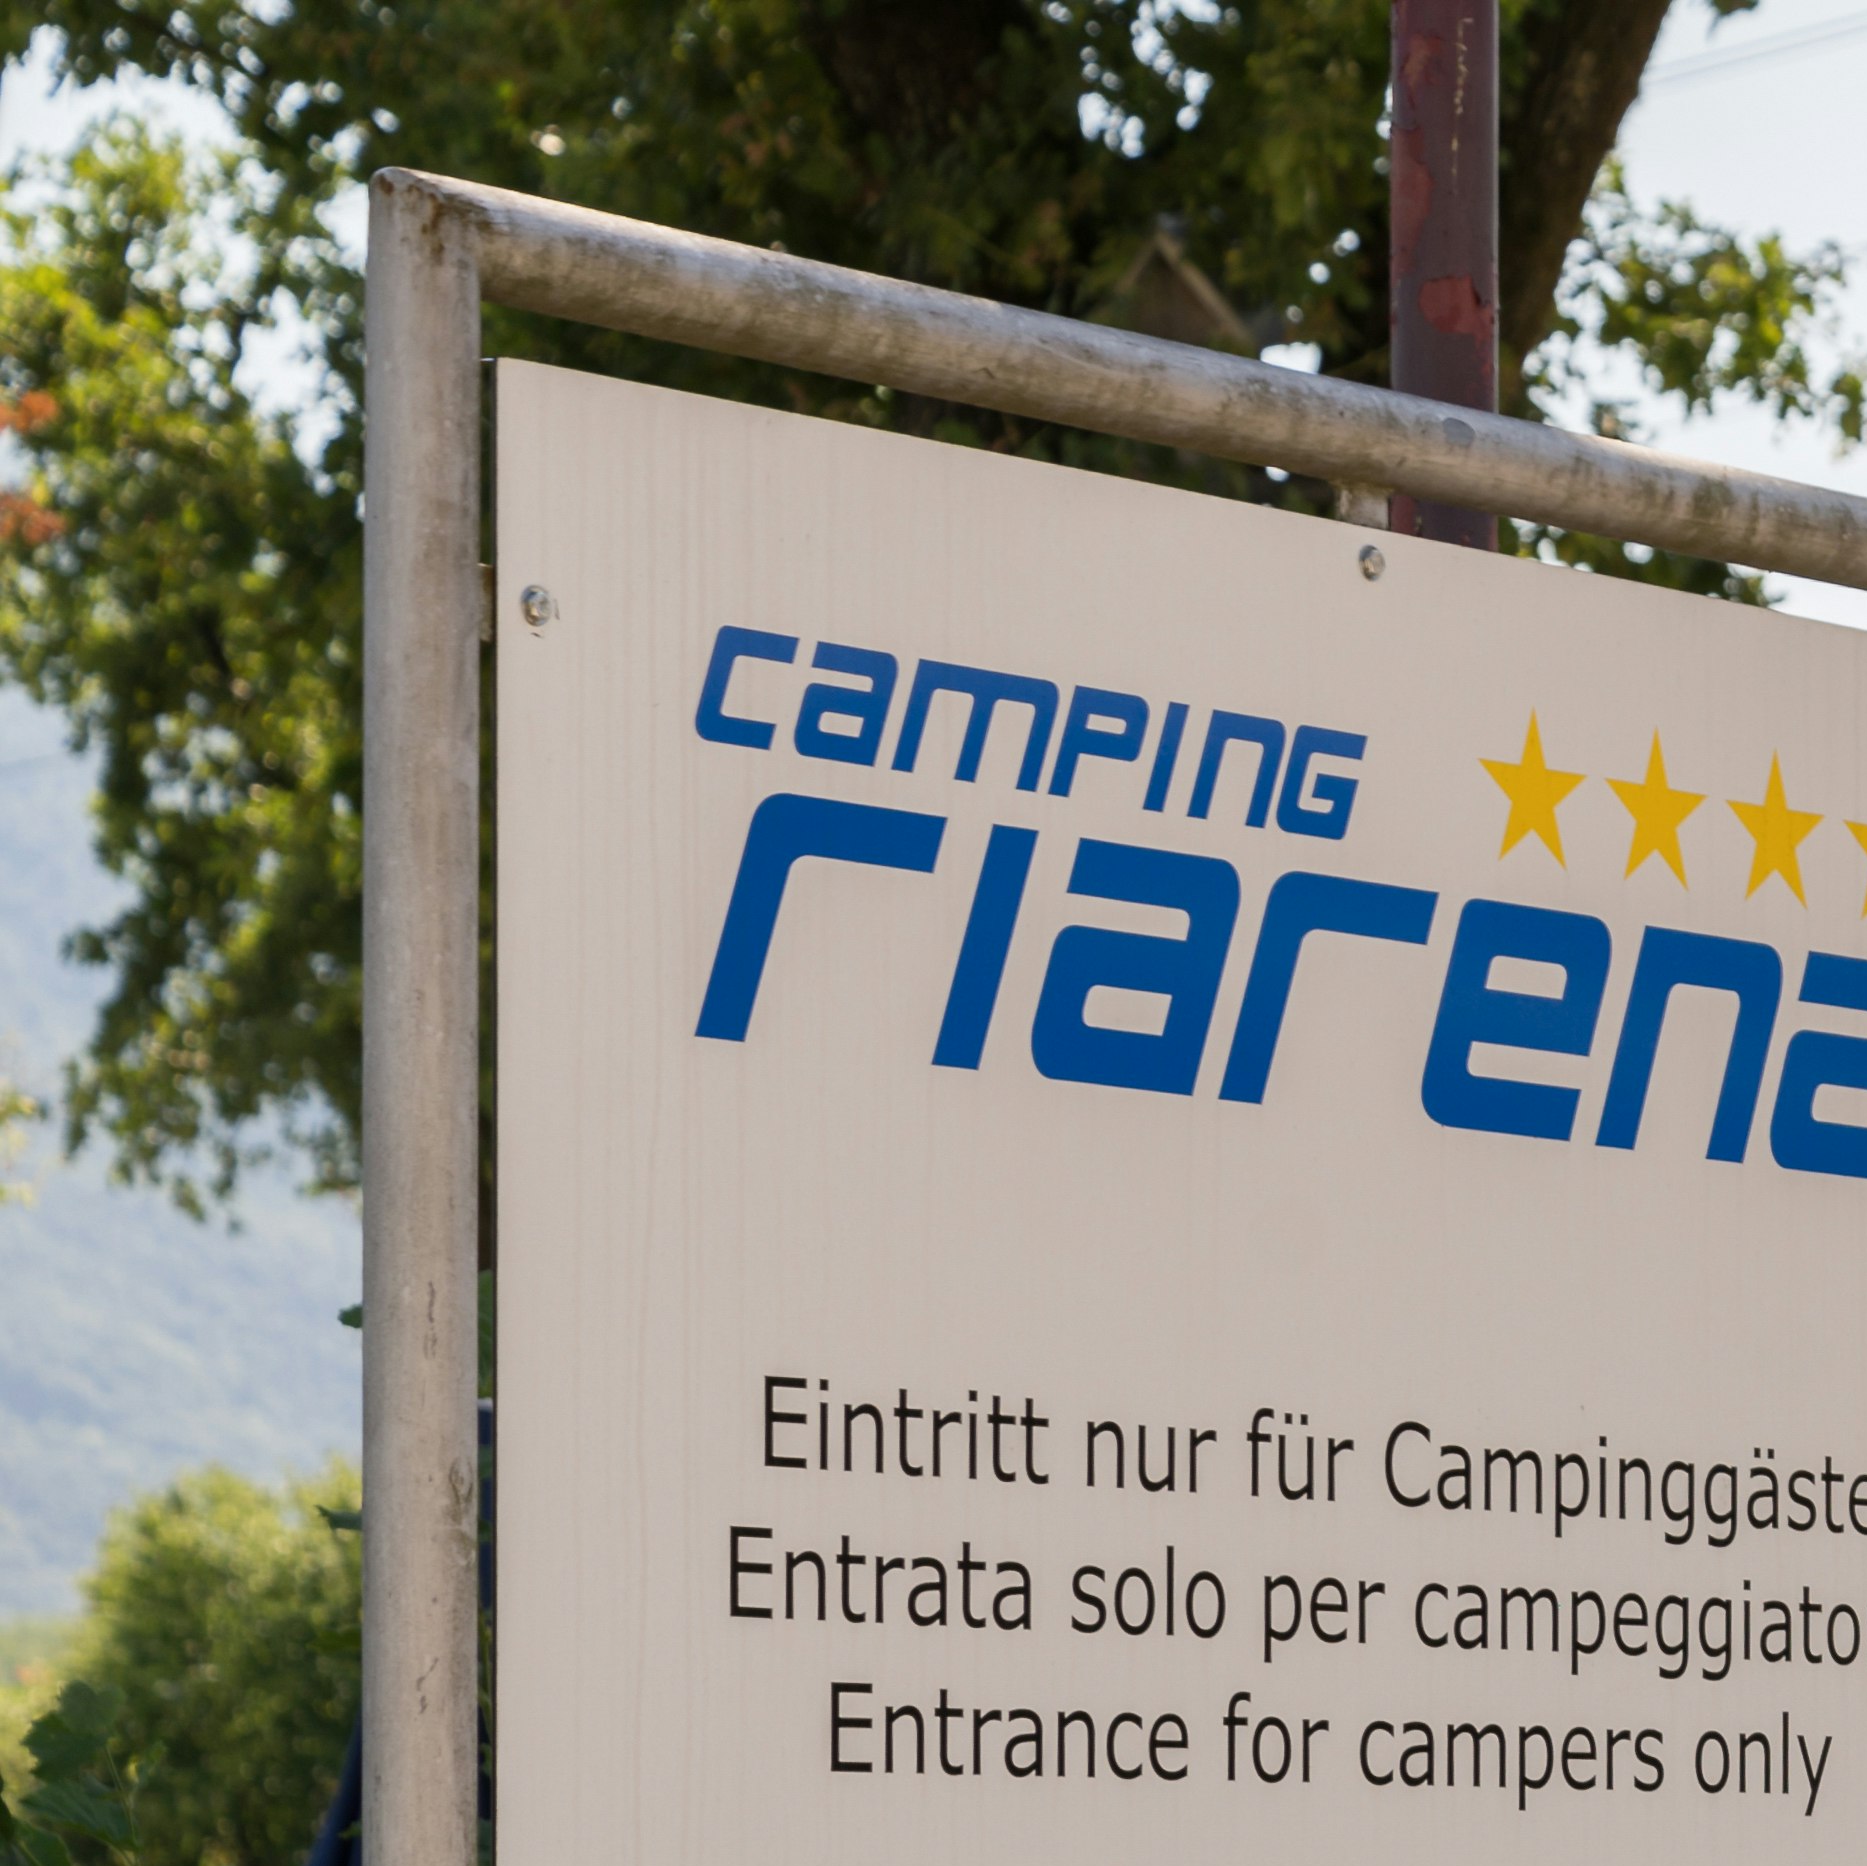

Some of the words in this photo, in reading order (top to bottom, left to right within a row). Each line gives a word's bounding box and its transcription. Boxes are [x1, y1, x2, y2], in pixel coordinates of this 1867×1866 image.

[762, 1374, 1051, 1486] Eintritt
[1085, 1419, 1219, 1495] nur
[1245, 1406, 1356, 1503] für
[728, 1524, 1033, 1632] Entrata
[1070, 1544, 1227, 1640] solo
[1262, 1573, 1387, 1665] per
[829, 1680, 1190, 1783] Entrance
[1221, 1690, 1331, 1785] for
[1358, 1719, 1666, 1813] campers
[1693, 1710, 1834, 1818] only
